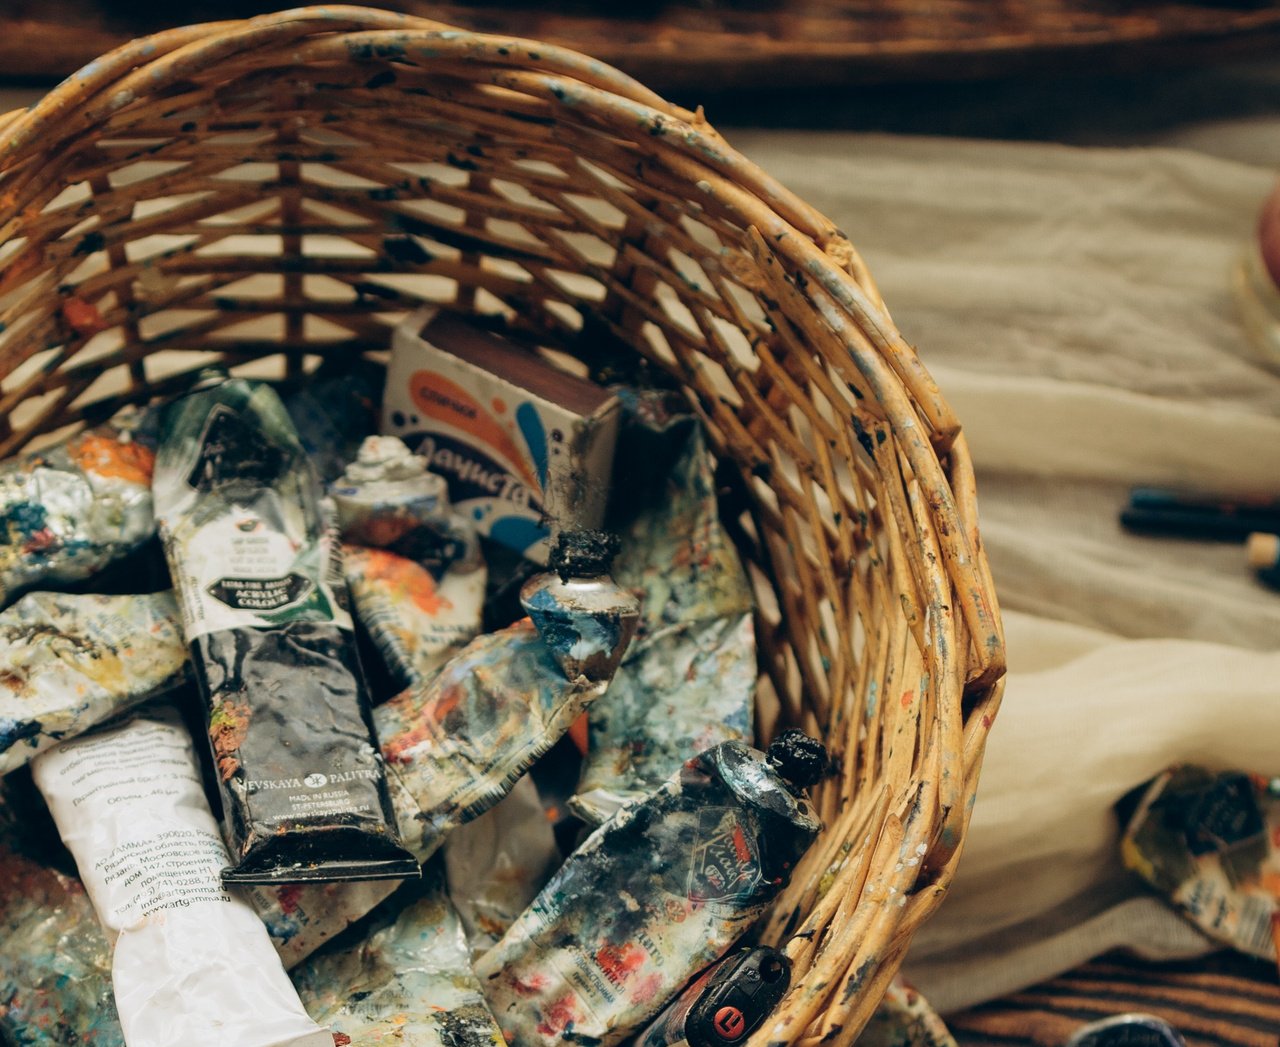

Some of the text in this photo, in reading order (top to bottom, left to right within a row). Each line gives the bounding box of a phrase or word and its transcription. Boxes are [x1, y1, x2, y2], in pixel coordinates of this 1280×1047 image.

[236, 587, 286, 598] ACRYLIC
[238, 594, 289, 607] COLOUR
[239, 770, 381, 792] NEVSKAYA PALITRA
[323, 790, 350, 798] RUSSIA
[156, 829, 195, 842] 390020,
[104, 848, 153, 873] Рязанская
[155, 840, 197, 850] область,
[140, 849, 200, 864] Московское
[124, 870, 142, 887] дом
[166, 858, 212, 869] строение
[141, 869, 197, 888] помещение
[140, 885, 228, 910] info@artgamma.ru
[143, 896, 231, 917] www.artgamma.ru
